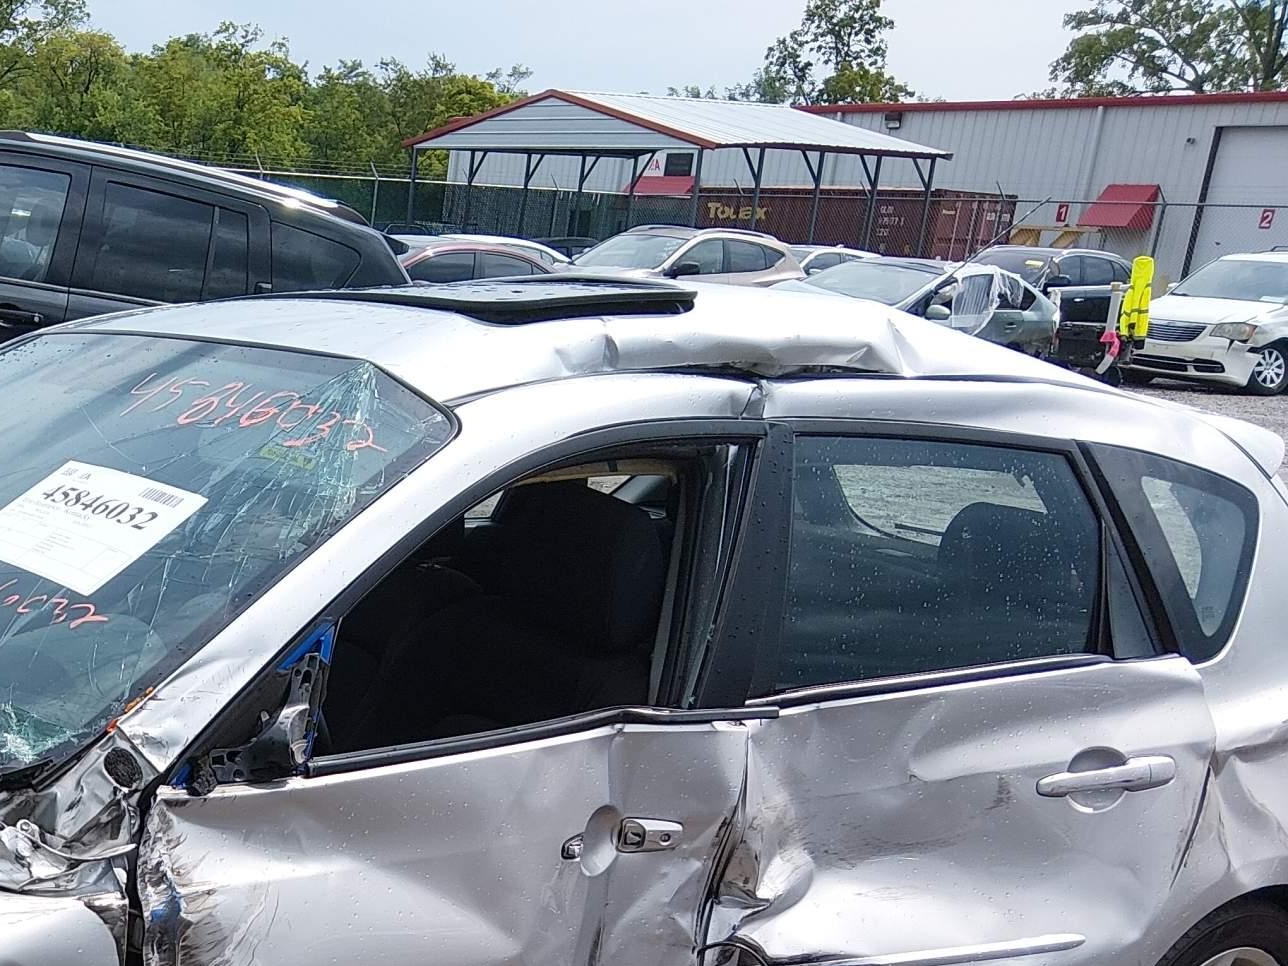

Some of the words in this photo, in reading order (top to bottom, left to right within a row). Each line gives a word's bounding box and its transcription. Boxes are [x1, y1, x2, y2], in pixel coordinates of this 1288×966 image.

[1058, 205, 1067, 220] 1
[1261, 210, 1274, 227] 2
[120, 372, 388, 453] 45846032
[41, 484, 160, 530] 45846032
